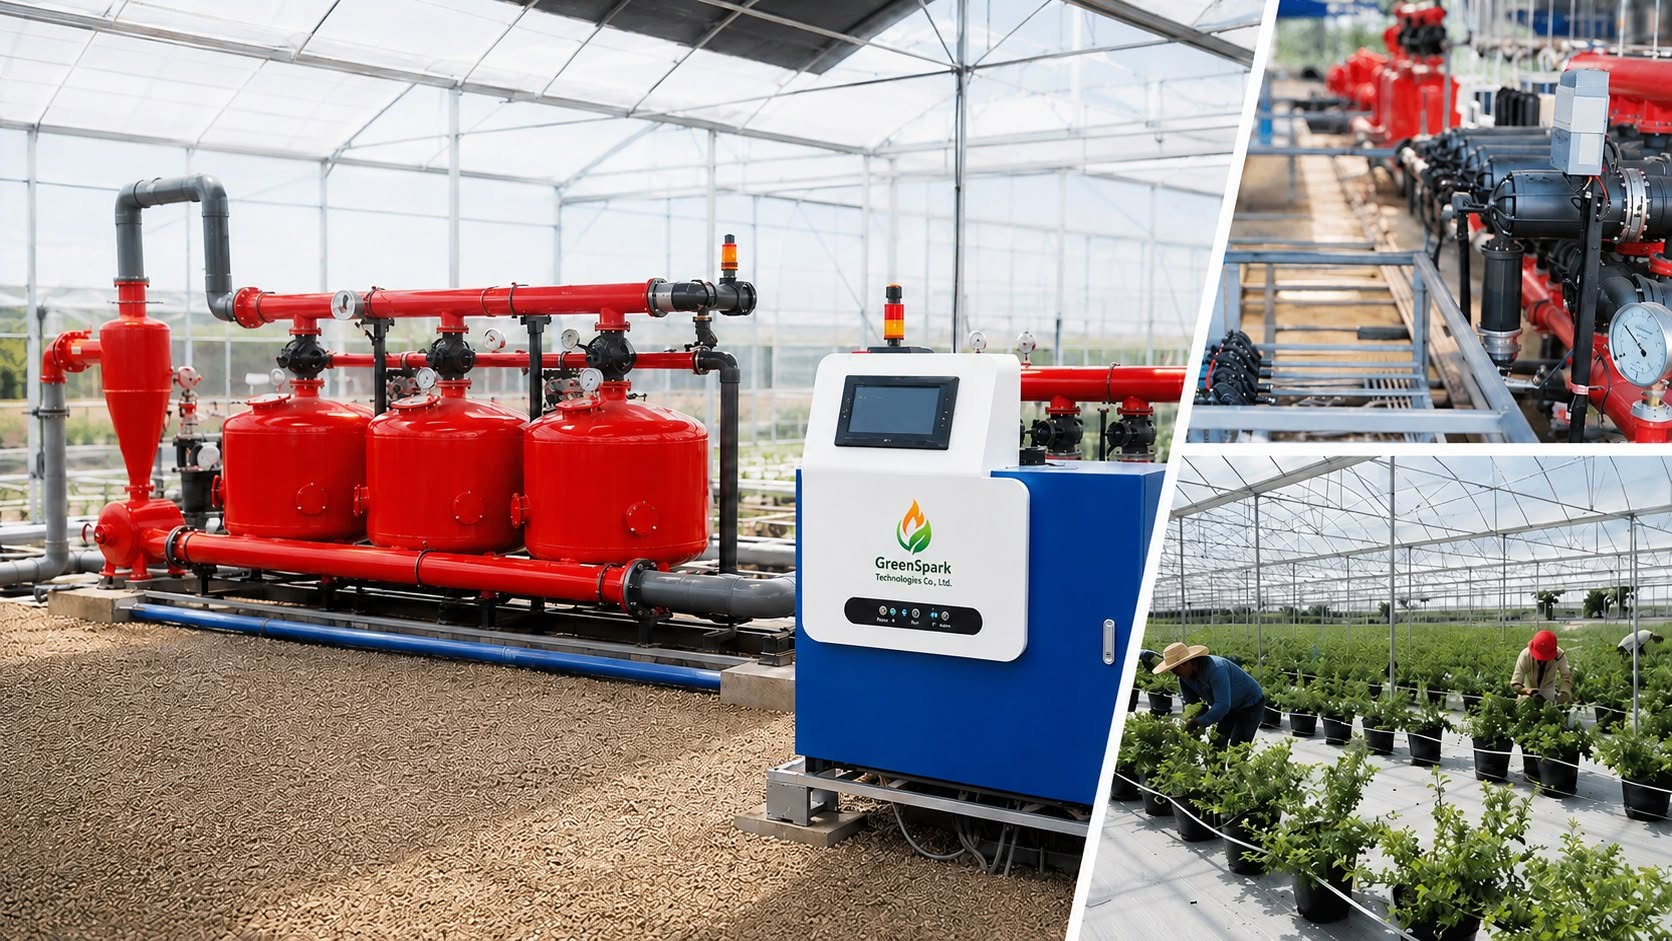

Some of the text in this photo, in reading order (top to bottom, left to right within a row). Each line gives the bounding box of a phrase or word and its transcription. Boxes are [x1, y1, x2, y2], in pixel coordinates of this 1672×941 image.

[875, 556, 952, 575] GreenSpark
[875, 573, 922, 586] Technologies
[938, 578, 953, 587] Ltd.
